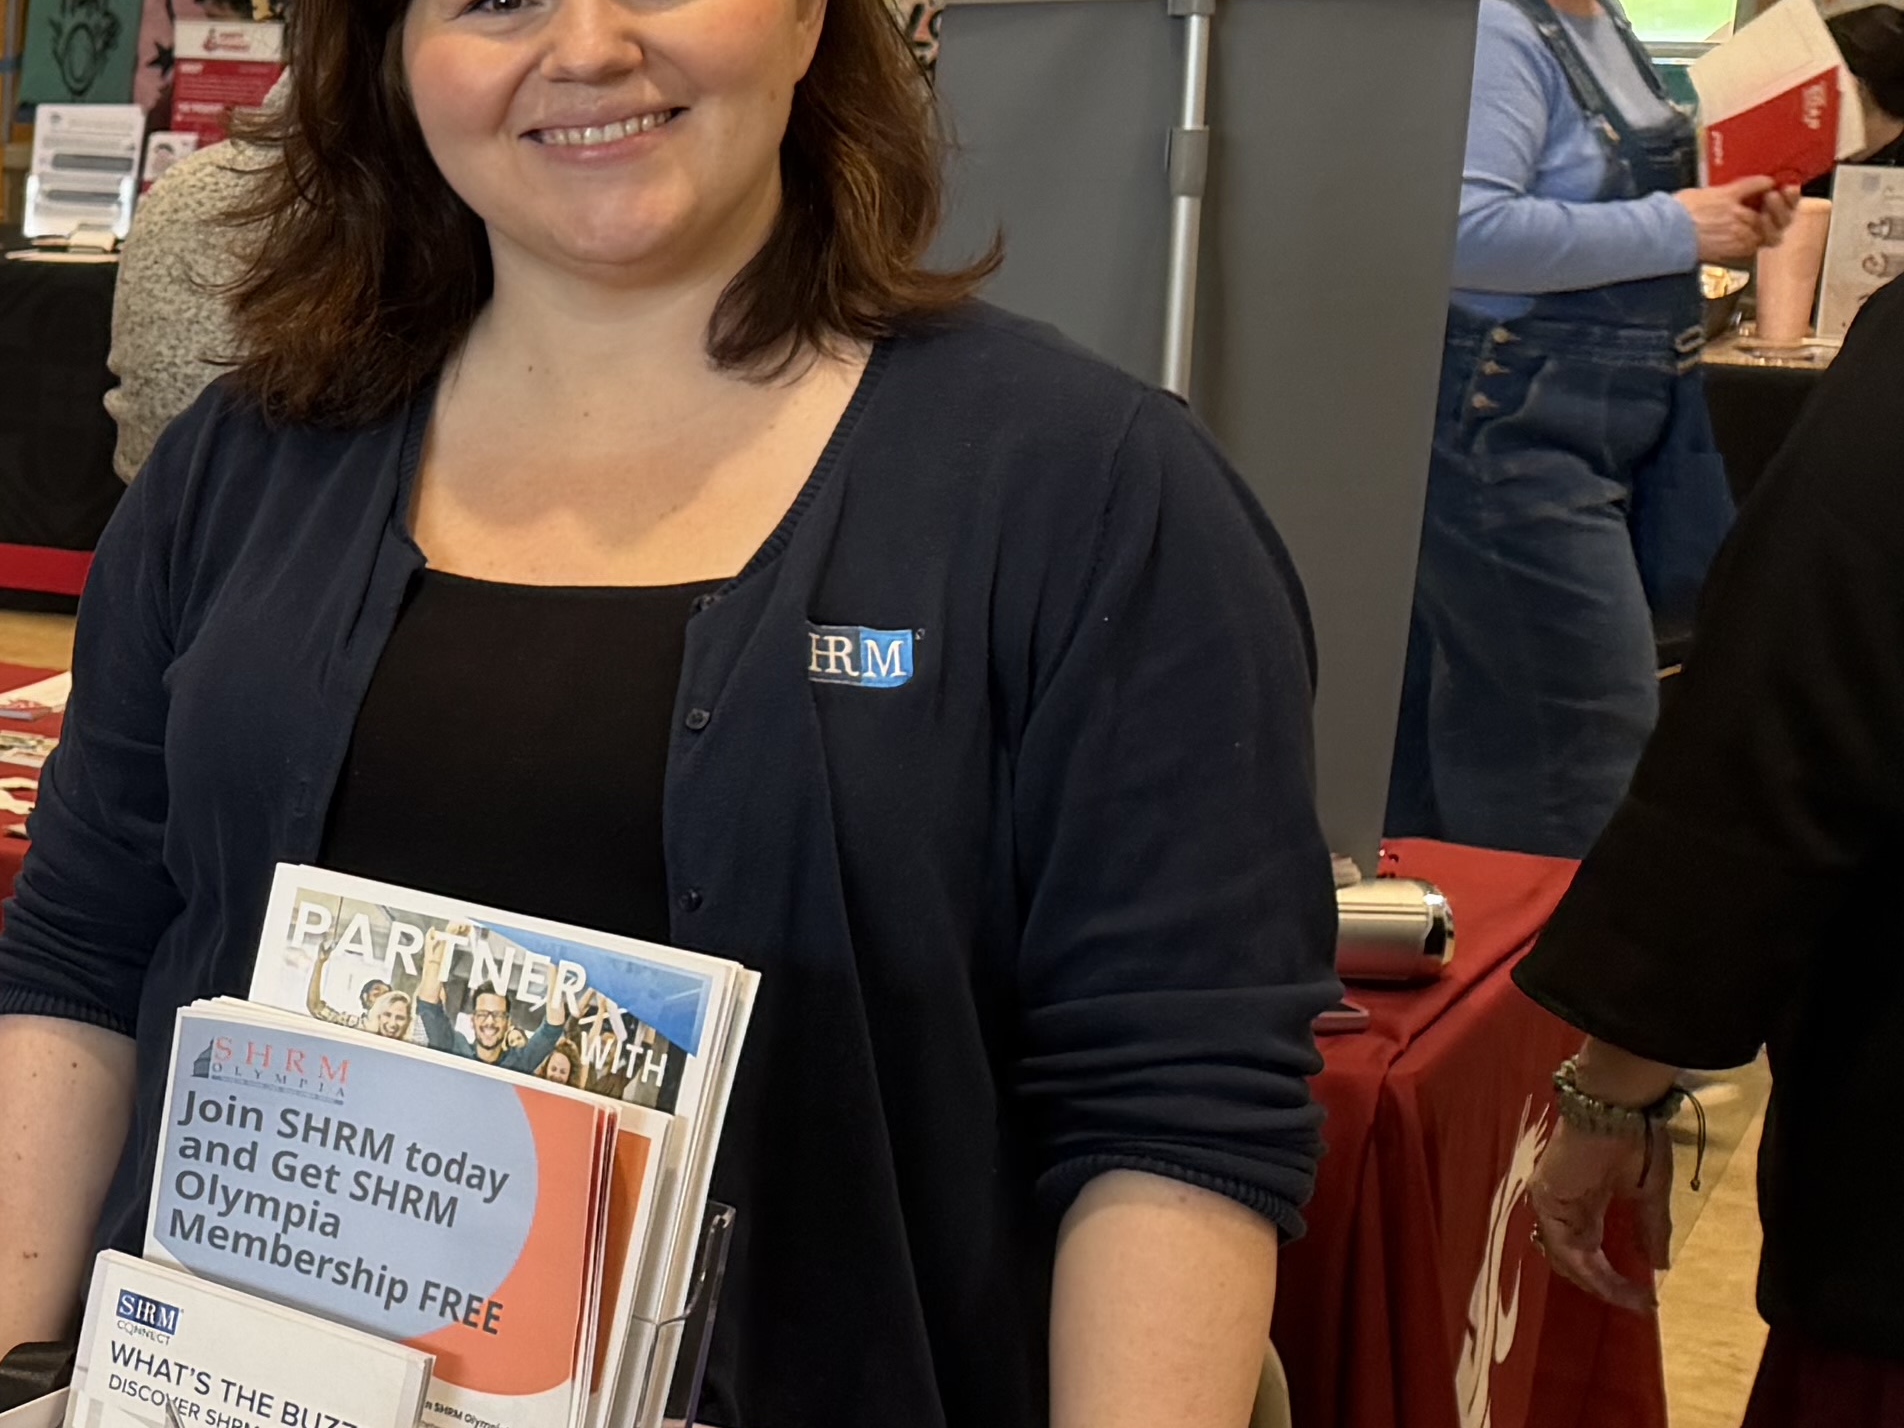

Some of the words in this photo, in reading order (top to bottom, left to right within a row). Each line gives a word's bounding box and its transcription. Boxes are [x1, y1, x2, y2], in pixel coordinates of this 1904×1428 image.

[291, 900, 586, 1016] PARTNER
[214, 1034, 350, 1085] SHRM
[580, 1030, 668, 1088] WITH
[177, 1090, 264, 1133] Join
[276, 1108, 394, 1167] SHRM
[404, 1141, 510, 1203] today
[178, 1136, 257, 1173] and
[271, 1151, 341, 1195] Get
[348, 1170, 458, 1229] SHRM
[174, 1170, 341, 1240] Olympia
[168, 1208, 408, 1311] Membership
[418, 1278, 503, 1336] FREE
[118, 1294, 177, 1332] SHRM
[109, 1374, 200, 1420] DISCOVER
[111, 1340, 212, 1396] WHAT'S
[220, 1378, 275, 1418] THE
